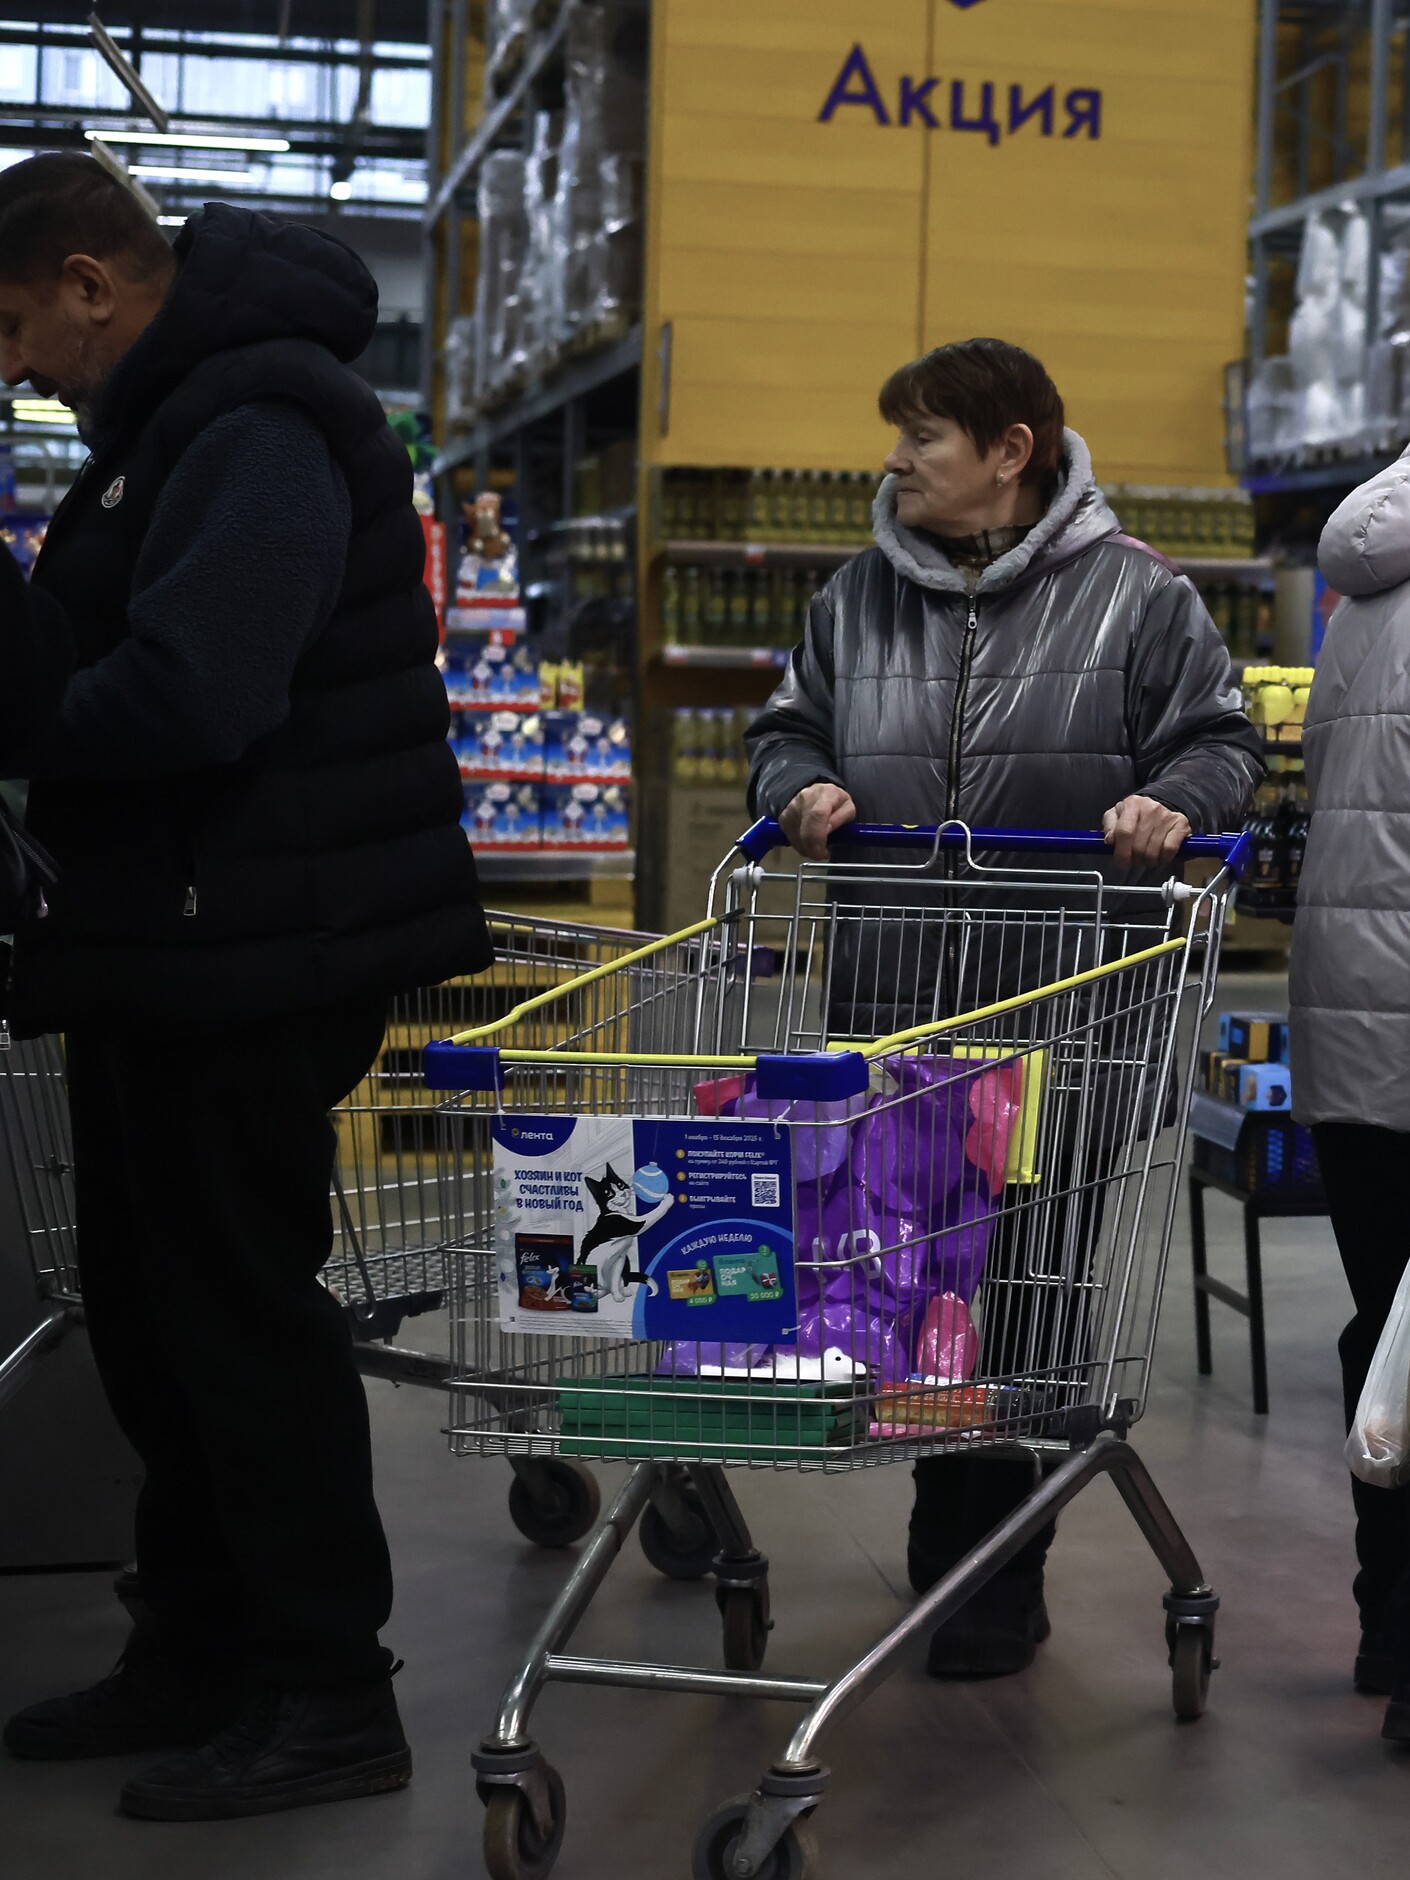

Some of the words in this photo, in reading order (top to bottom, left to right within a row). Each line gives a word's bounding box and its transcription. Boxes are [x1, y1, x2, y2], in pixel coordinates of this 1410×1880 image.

[817, 42, 1101, 147] Акция
[520, 1131, 554, 1141] лента
[514, 1170, 553, 1181] ХОЗЯИН
[555, 1171, 562, 1181] И
[563, 1172, 583, 1182] КОТ
[520, 1184, 579, 1196] СЧАСТЛИВЫ
[516, 1198, 524, 1209] В
[525, 1197, 561, 1210] НОВЫЙ
[563, 1199, 584, 1212] ГОД
[681, 1235, 717, 1255] КАЖДУЮ
[718, 1233, 753, 1243] НЕДЕЛЮ
